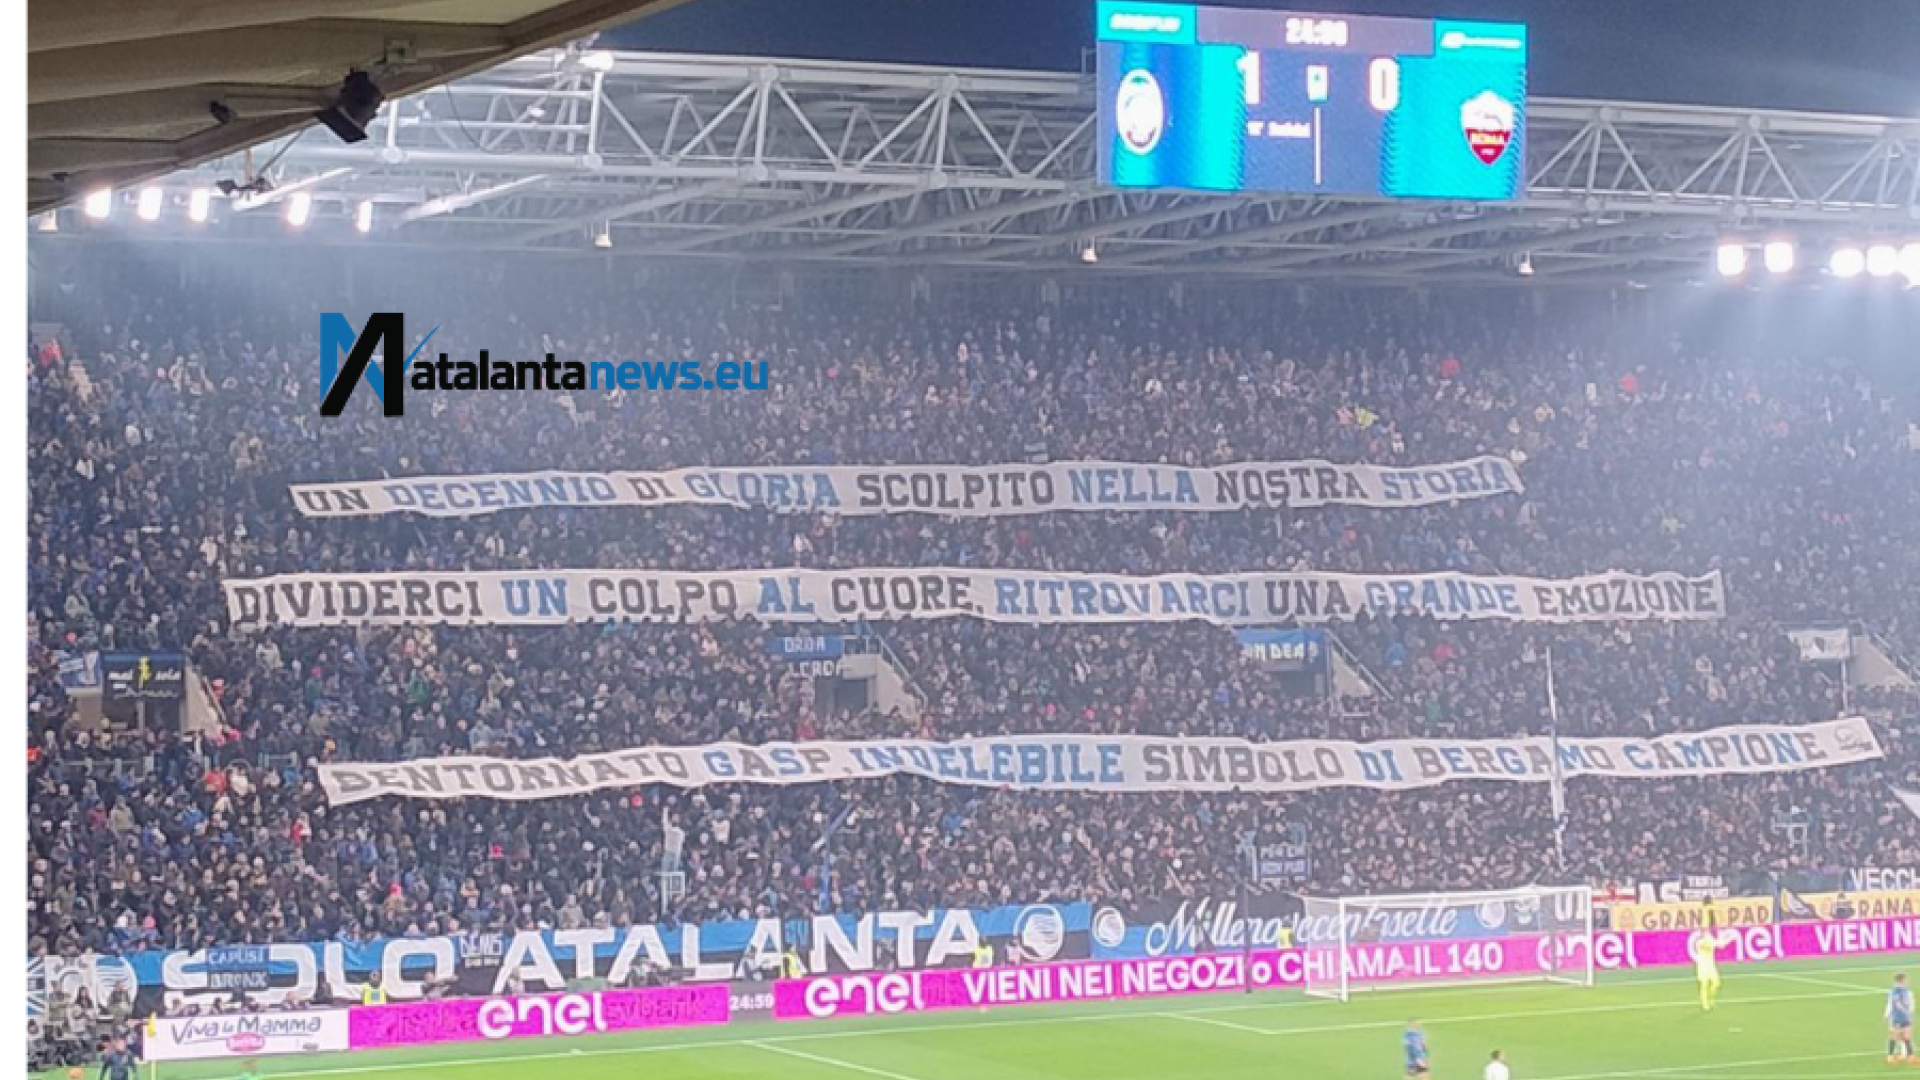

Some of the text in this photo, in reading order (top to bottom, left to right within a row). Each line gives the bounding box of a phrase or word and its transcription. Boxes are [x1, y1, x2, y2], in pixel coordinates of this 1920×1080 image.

[1236, 50, 1260, 105] 1
[1368, 57, 1399, 112] 0
[298, 459, 1514, 511] UN DECENNIO DI GLORIA SCOLPITO NELLA NOSTRA STORIA
[233, 580, 483, 623] DIVIDERCI
[501, 578, 568, 615] UN
[588, 577, 737, 616] COLPO
[757, 576, 814, 613] AL
[993, 577, 1251, 616] RITROVARCI
[1264, 580, 1351, 615] UNA
[1364, 579, 1523, 615] GRANDE
[1533, 579, 1718, 617] EMOZIONE
[331, 751, 690, 793] BENTORNATO
[848, 743, 1125, 784] INDELEBILE
[1143, 743, 1345, 783] SIMBOLO
[1354, 748, 1403, 782] DI
[1412, 745, 1616, 779] BERGAMO
[1623, 732, 1827, 771] CAMPIONE
[1642, 905, 1718, 930] GRAN
[491, 908, 981, 996] ATALANTA
[804, 971, 924, 1016] enel
[963, 966, 1051, 1004] VIENI
[1059, 960, 1113, 998] NEI
[1121, 953, 1245, 994] NEGOZI
[1277, 943, 1406, 983] CHIAMA
[1412, 944, 1441, 976] IL
[1447, 941, 1504, 974] 140
[1536, 929, 1638, 973] enel
[1814, 921, 1888, 953] VIENI
[477, 991, 608, 1038] enel
